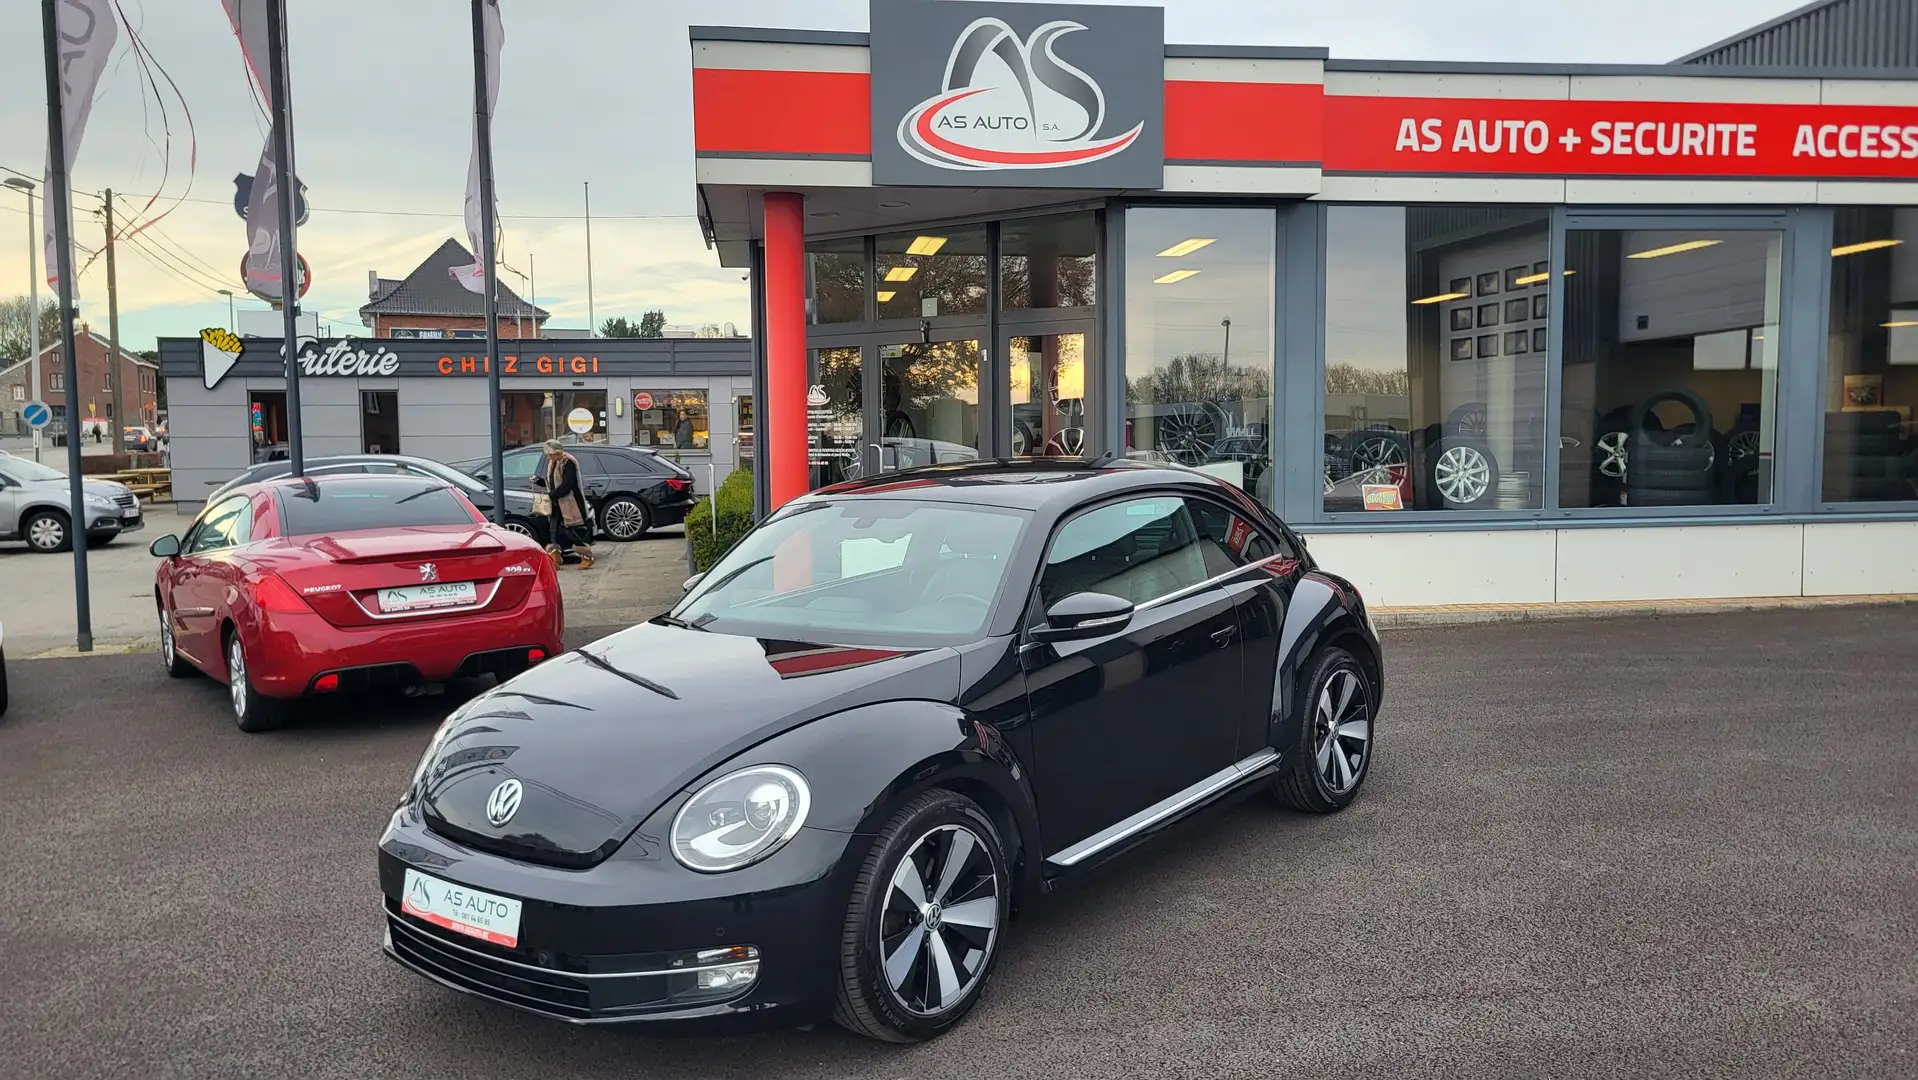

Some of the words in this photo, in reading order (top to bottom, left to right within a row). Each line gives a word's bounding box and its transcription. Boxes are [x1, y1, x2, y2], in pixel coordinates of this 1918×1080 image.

[937, 115, 968, 130] AS
[973, 115, 1028, 130] AUTO
[1042, 123, 1061, 131] S.A.
[1396, 119, 1442, 152] AS
[1452, 120, 1549, 154] AUTO
[1590, 122, 1757, 156] SECURITE
[1792, 124, 1918, 159] ACCESS
[438, 356, 518, 374] CHZ
[537, 355, 599, 373] GIGI
[303, 584, 342, 594] PEUGEOT
[420, 586, 436, 595] AS
[438, 584, 468, 593] AUTO
[444, 889, 463, 907] AS
[465, 895, 508, 919] AUTO
